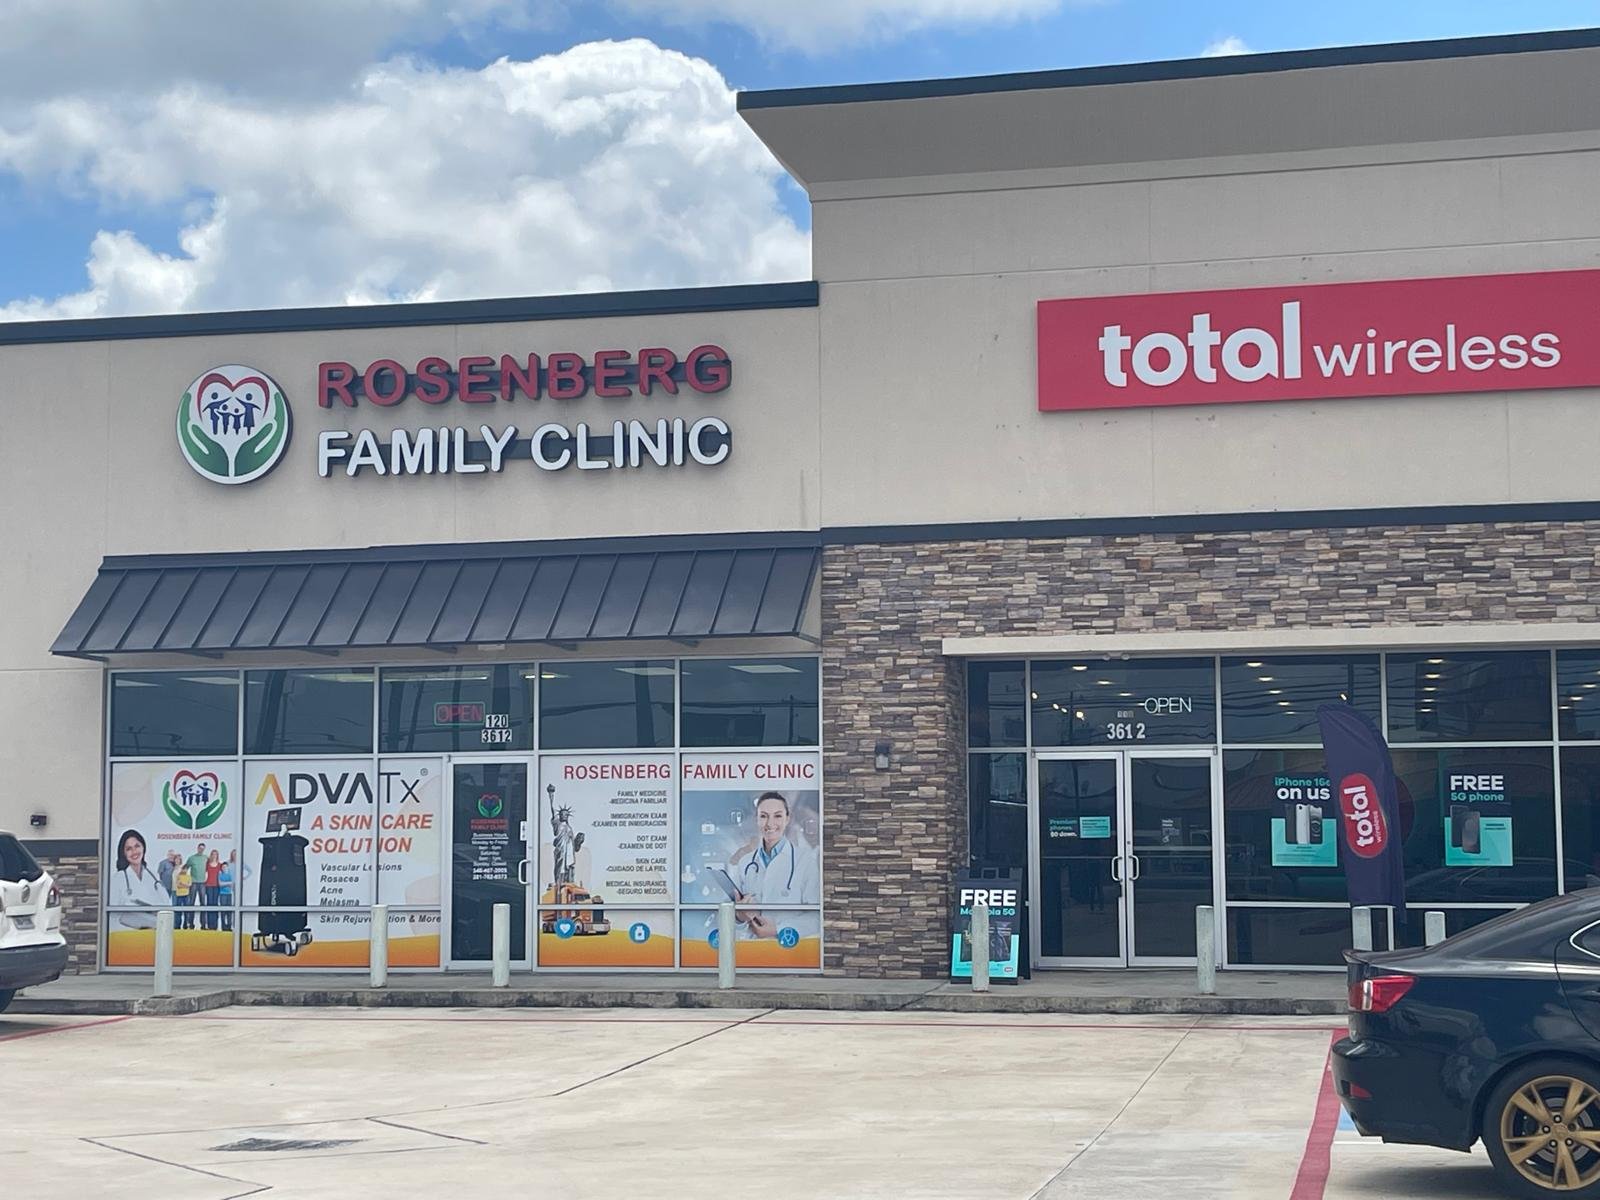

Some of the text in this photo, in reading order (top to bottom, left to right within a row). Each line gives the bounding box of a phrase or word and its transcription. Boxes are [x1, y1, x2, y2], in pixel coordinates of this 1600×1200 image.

[1099, 301, 1562, 388] total wireless
[318, 344, 732, 407] ROSENBERG
[318, 416, 731, 477] FAMILY CLINIC
[1144, 697, 1192, 714] OPEN
[437, 705, 483, 723] OPEN
[487, 715, 508, 727] 120
[482, 730, 512, 742] 3612
[1106, 723, 1146, 740] 3612
[564, 763, 815, 780] ROSENBERG FAMILY CLINIC
[1275, 777, 1313, 787] iPhone
[1450, 775, 1504, 790] FREE
[1277, 787, 1330, 800] on us
[1451, 792, 1504, 802] 5G phone
[311, 814, 433, 830] A SKIN CARE
[1344, 785, 1374, 847] total
[311, 837, 412, 854] SOLUTION
[321, 863, 360, 872] Vascular
[320, 875, 359, 883] Rosacea
[320, 886, 343, 894] Acne
[961, 889, 1017, 906] FREE
[320, 898, 360, 907] Melasma
[320, 915, 340, 923] Skin
[409, 915, 416, 923] &
[418, 914, 441, 923] More
